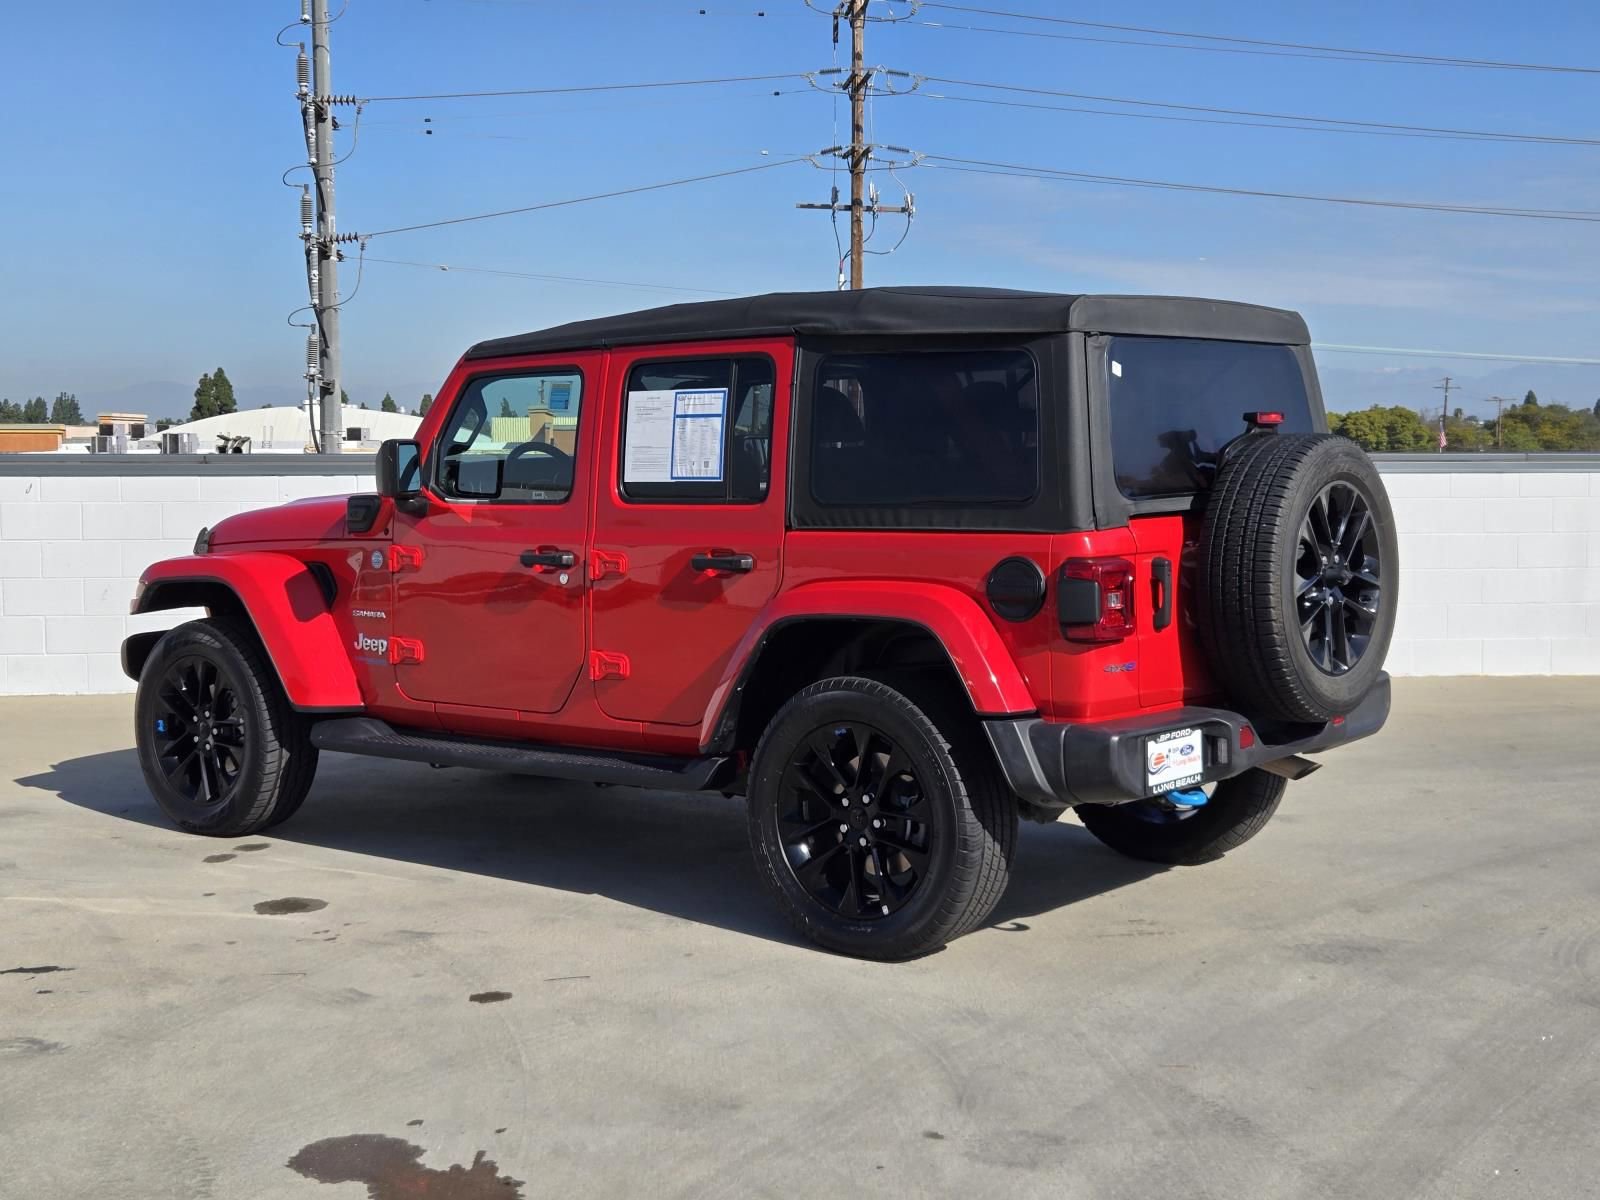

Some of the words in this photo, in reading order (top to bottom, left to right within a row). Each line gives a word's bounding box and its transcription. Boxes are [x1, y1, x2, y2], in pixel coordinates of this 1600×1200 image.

[352, 610, 386, 619] SAHARA
[354, 632, 388, 656] Jeep
[1170, 728, 1191, 740] FORD
[1152, 781, 1175, 794] LONG
[1175, 773, 1201, 788] BEACH
